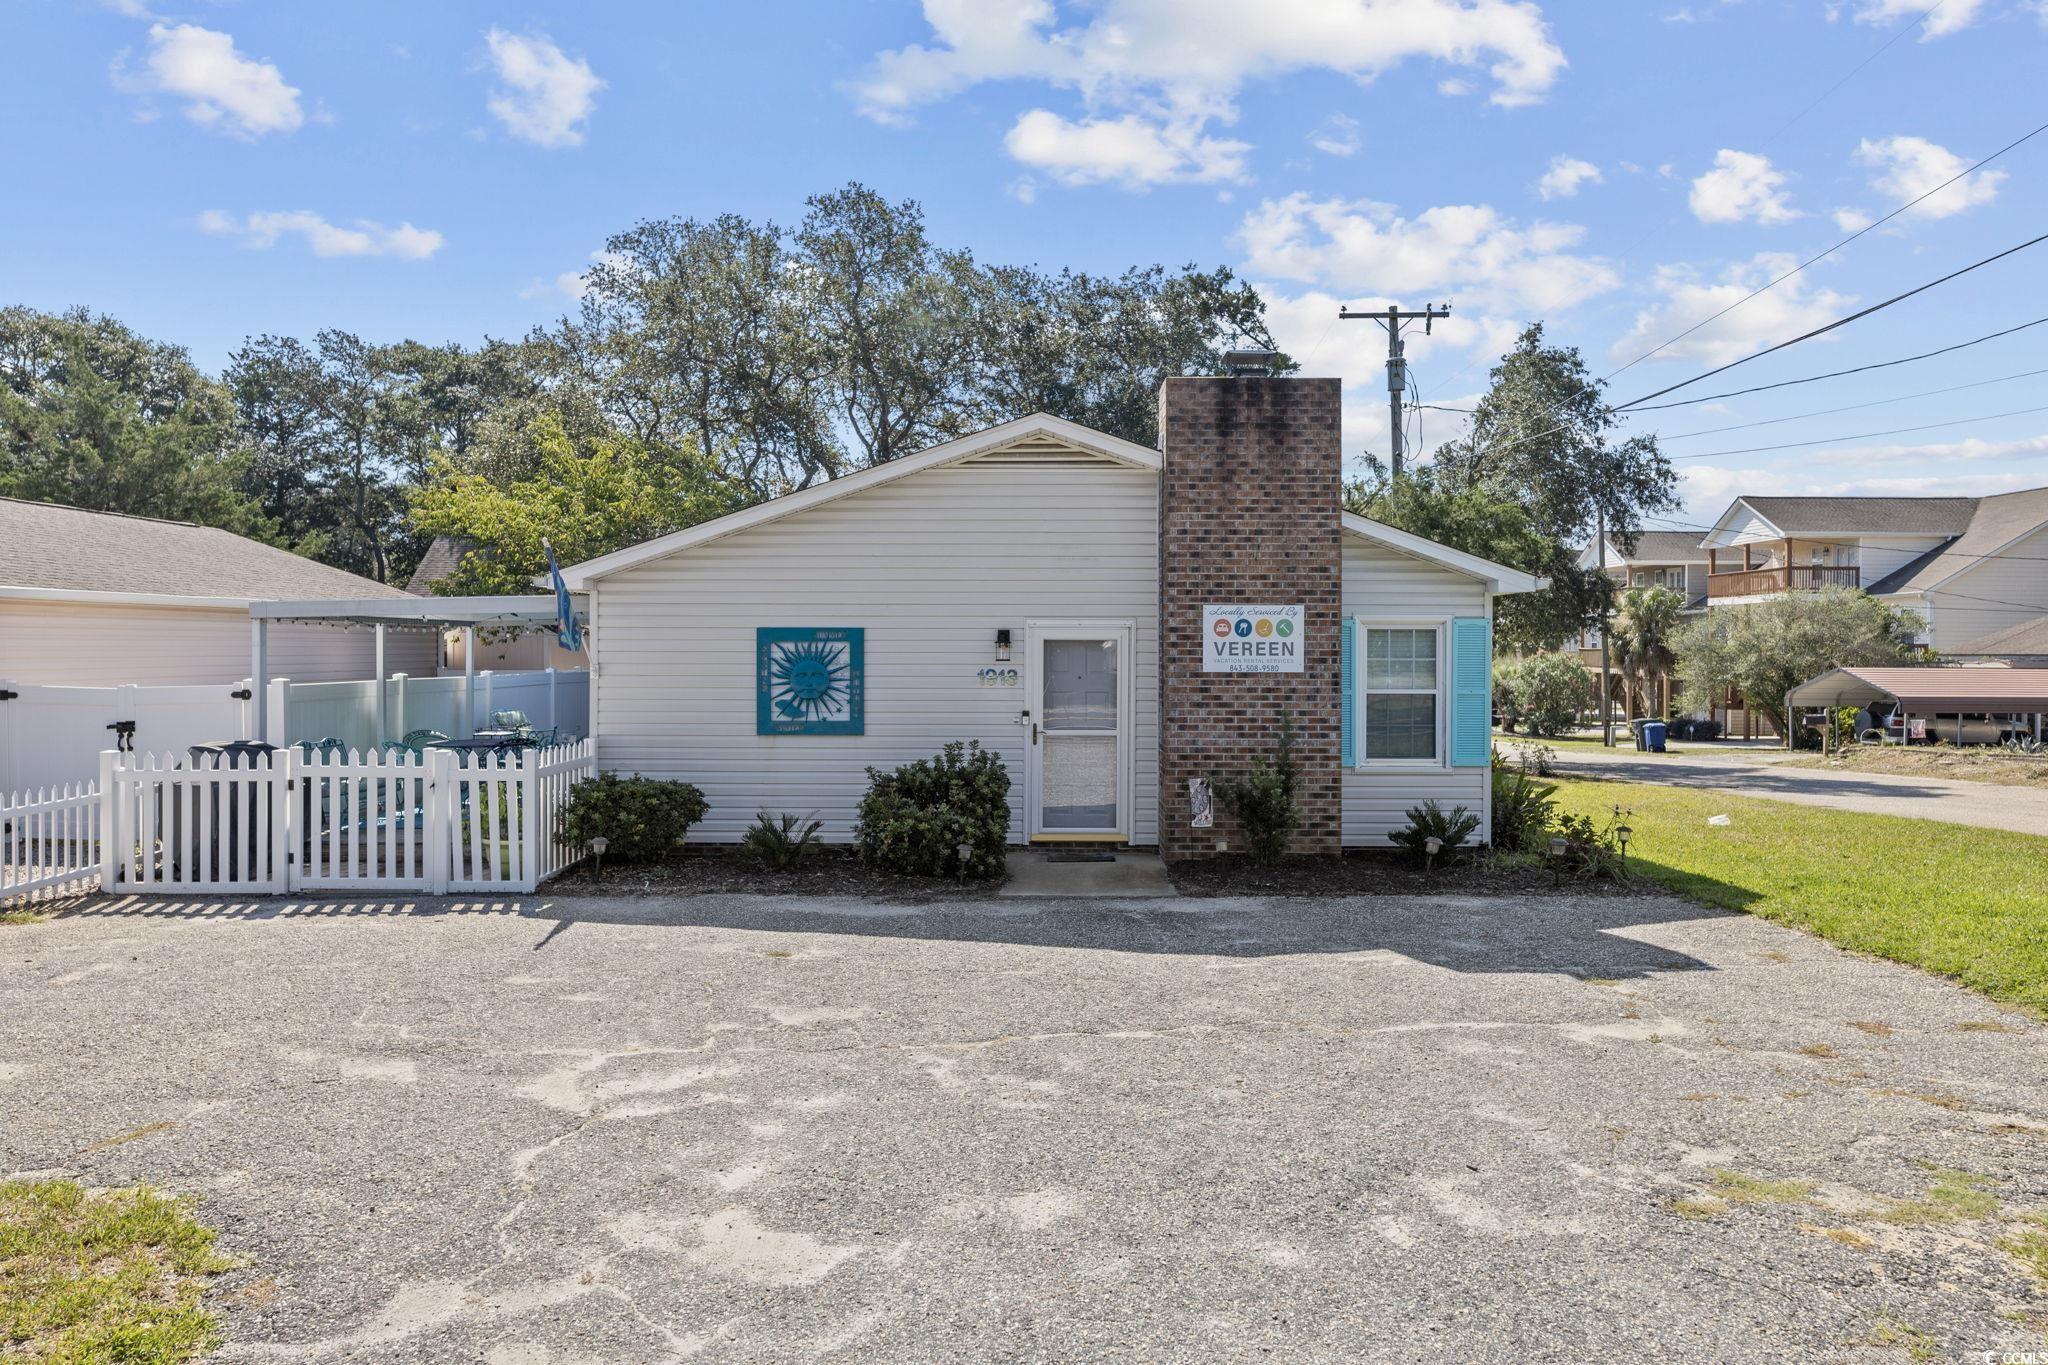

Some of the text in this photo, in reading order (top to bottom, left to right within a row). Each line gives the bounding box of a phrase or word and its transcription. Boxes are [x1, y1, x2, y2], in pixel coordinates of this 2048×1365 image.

[1209, 606, 1298, 618] Locally Serviced By
[1213, 641, 1295, 656] VEREEN
[1229, 664, 1280, 672] 843-508-9580
[977, 668, 1017, 686] 1913
